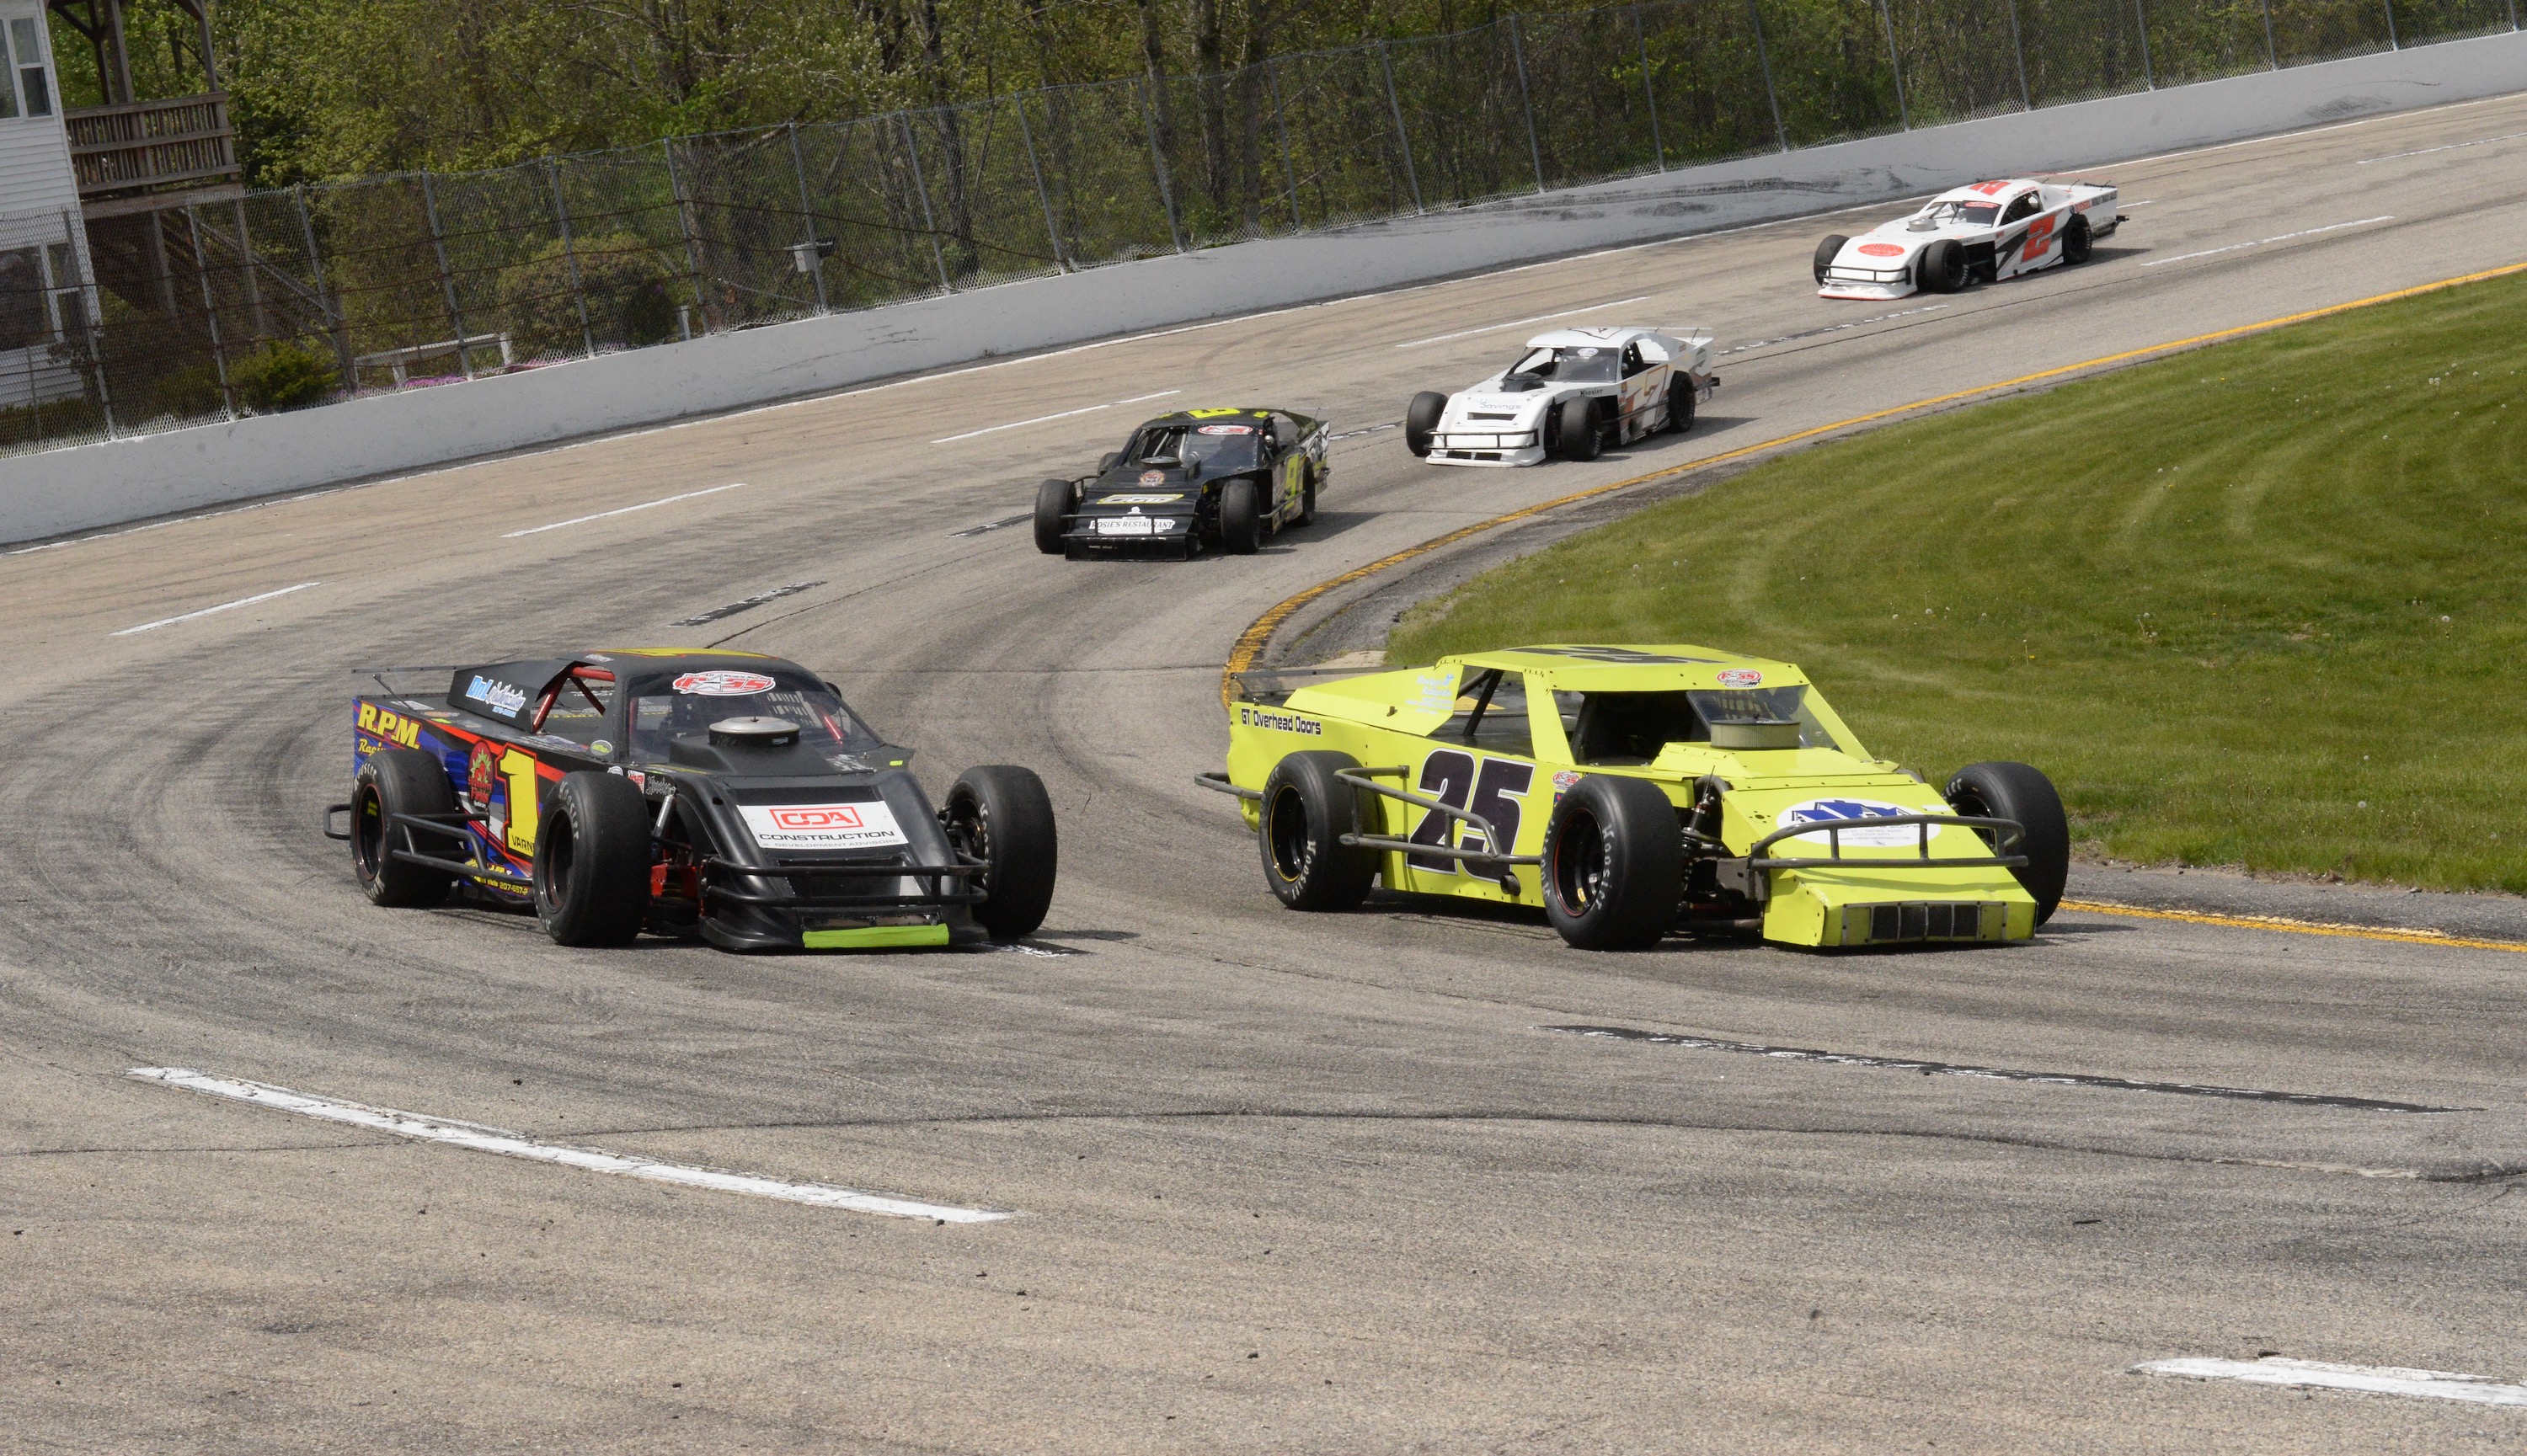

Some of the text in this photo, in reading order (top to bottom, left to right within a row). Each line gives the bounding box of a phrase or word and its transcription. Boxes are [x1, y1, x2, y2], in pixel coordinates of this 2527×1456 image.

[2022, 214, 2057, 263] 2
[1480, 402, 1522, 410] Savings
[1241, 708, 1322, 735] GT Overhead Doors
[359, 738, 386, 756] Raci
[500, 748, 539, 857] 1
[1406, 747, 1536, 884] 25
[780, 811, 855, 826] CDA
[759, 830, 895, 841] CONSTRUCTION
[1595, 824, 1615, 910] Hoosier
